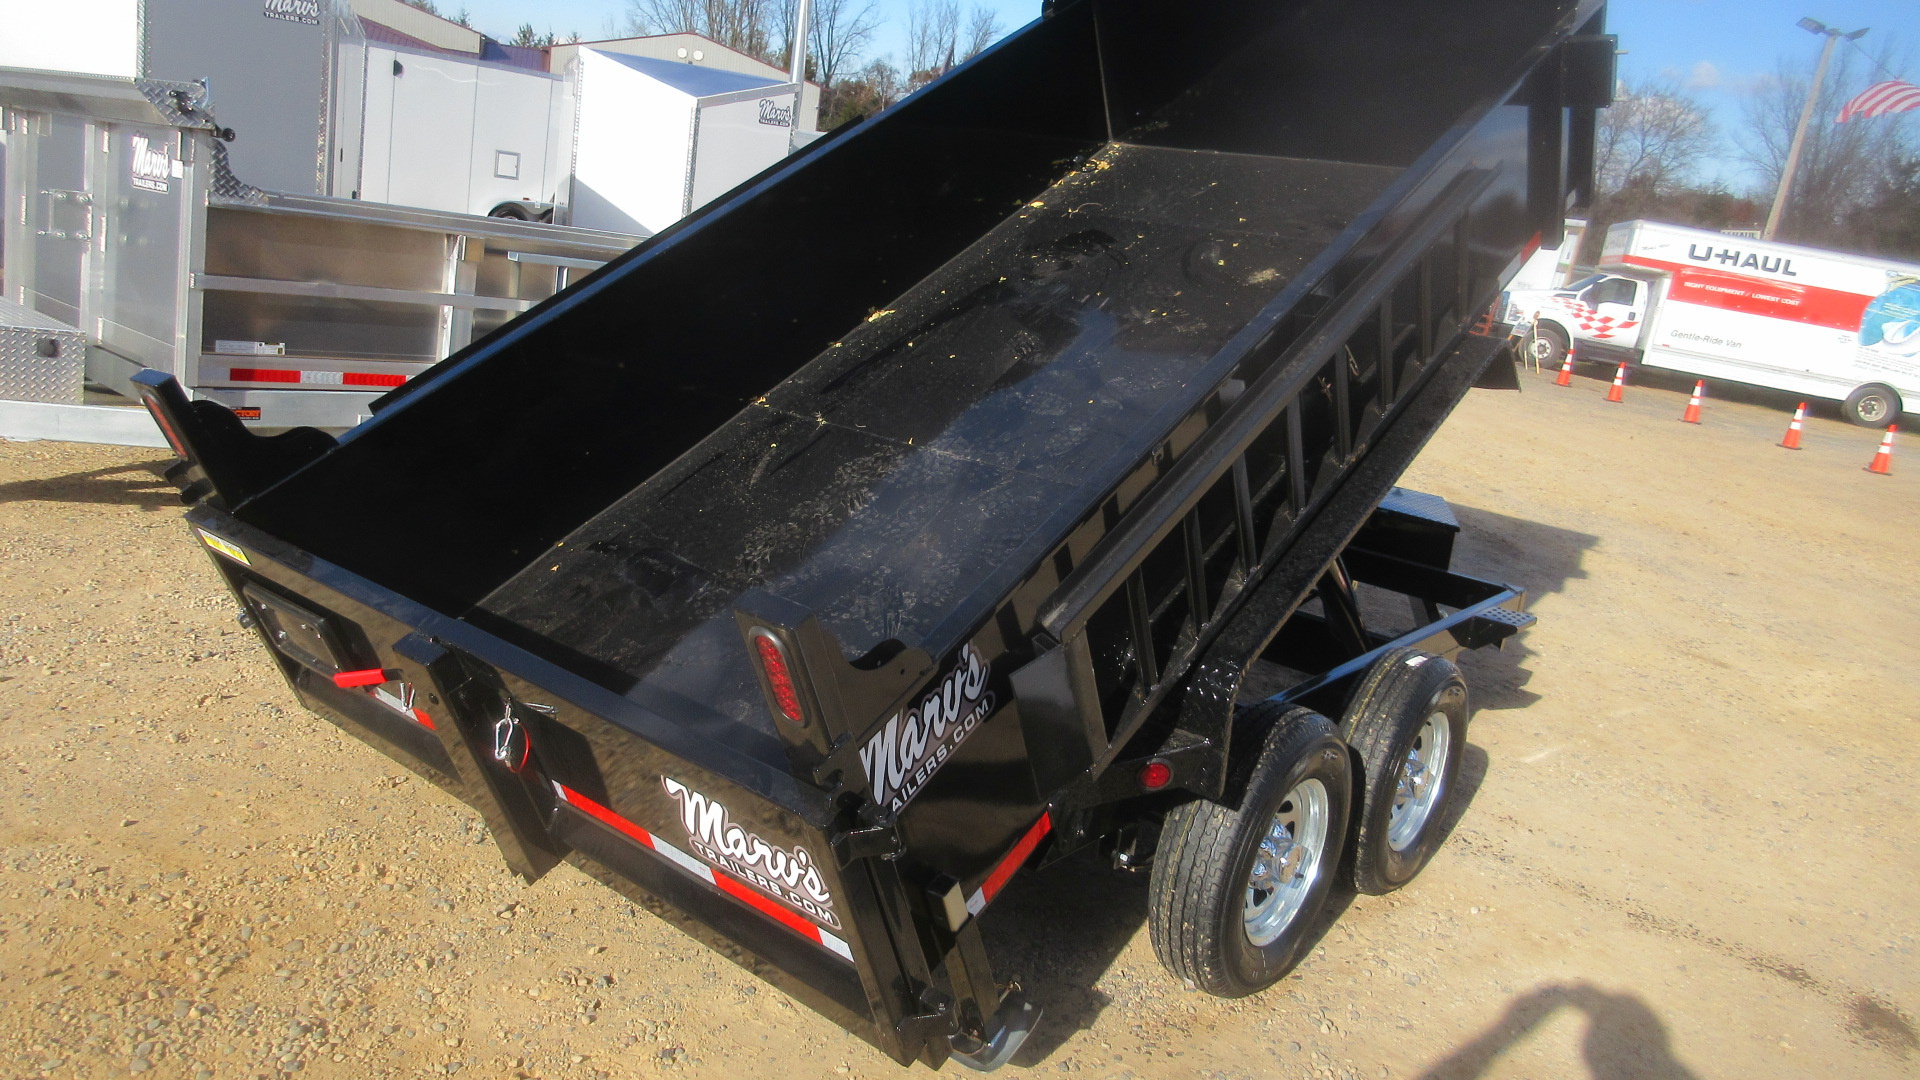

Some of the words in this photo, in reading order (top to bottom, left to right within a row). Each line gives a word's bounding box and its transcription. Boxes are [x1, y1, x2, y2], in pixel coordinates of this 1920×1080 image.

[265, 11, 319, 25] TRAILERS.COM
[1688, 243, 1797, 276] U-HAUL
[1705, 284, 1745, 296] EQUIPMENT
[1751, 293, 1780, 302] LOWEST
[1670, 329, 1724, 345] Gentle-Ride
[1726, 339, 1742, 349] Van
[859, 643, 986, 805] Marv's
[892, 698, 989, 812] AILERS.COM
[665, 777, 831, 902] Marv's
[694, 841, 834, 924] TRAILERS.COM
